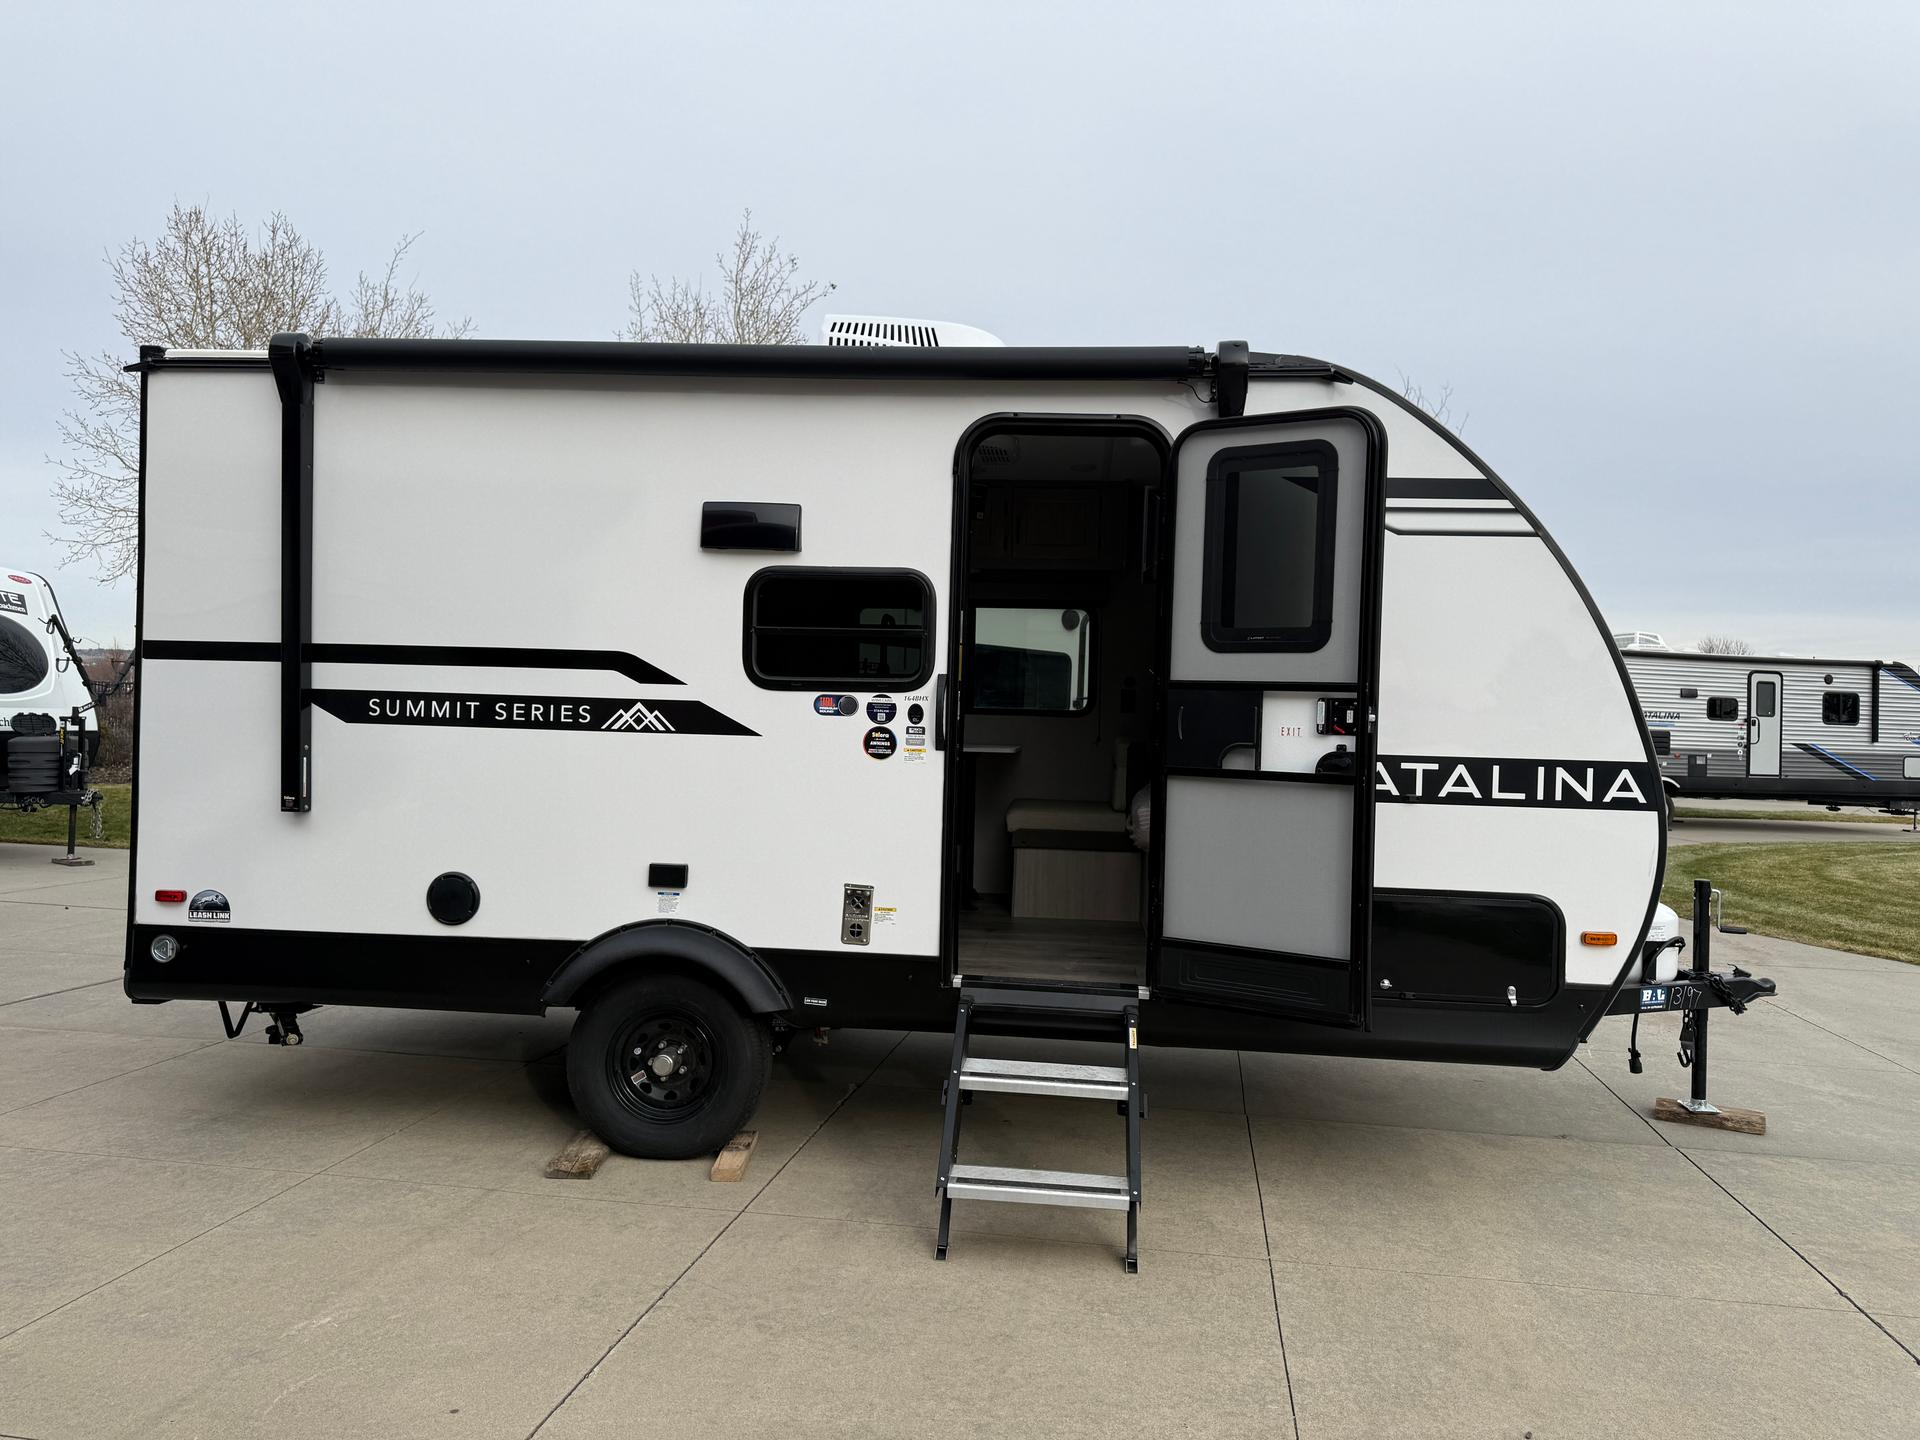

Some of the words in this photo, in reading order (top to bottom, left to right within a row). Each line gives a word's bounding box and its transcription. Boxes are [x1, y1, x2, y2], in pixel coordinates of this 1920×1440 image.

[368, 698, 480, 720] SUMMIT
[495, 702, 591, 724] SERIES
[1281, 726, 1301, 736] EXIT
